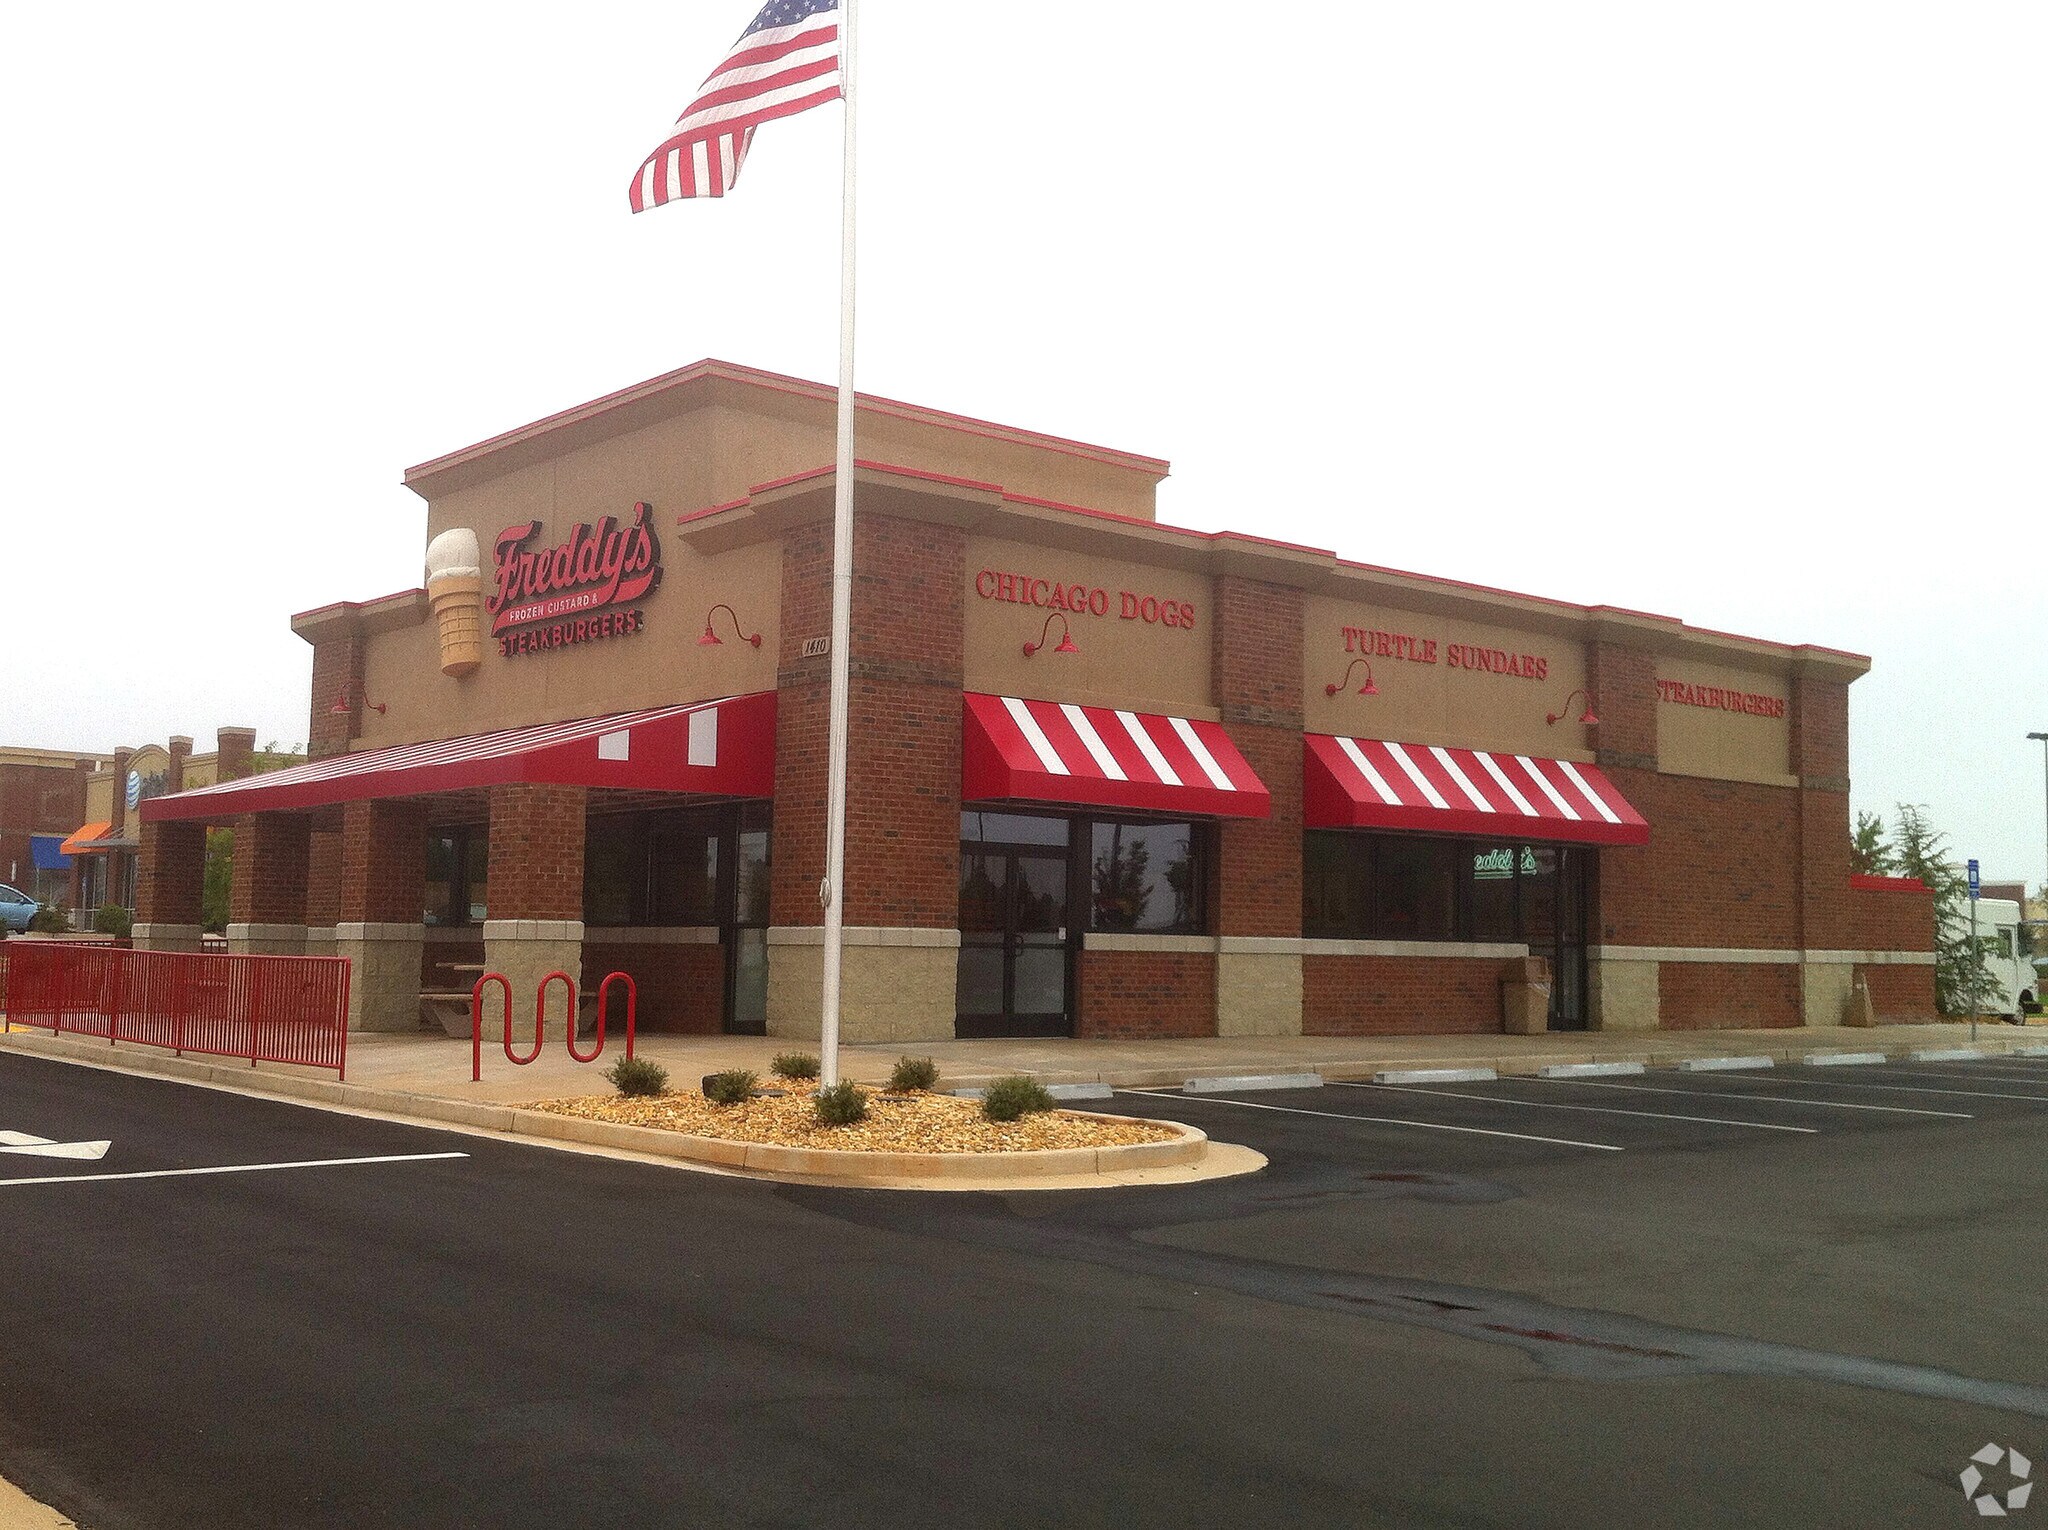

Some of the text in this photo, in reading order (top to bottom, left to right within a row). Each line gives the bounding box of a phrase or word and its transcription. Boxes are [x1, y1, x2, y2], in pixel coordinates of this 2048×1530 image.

[485, 501, 658, 615] Freddy's
[509, 592, 599, 622] FROZEN CUSTARD &
[975, 568, 1196, 630] CHICAGO DOGS
[498, 609, 638, 657] STEAKBURGERS
[804, 639, 827, 654] 1410
[1341, 626, 1548, 681] TURTLE SUNDAES
